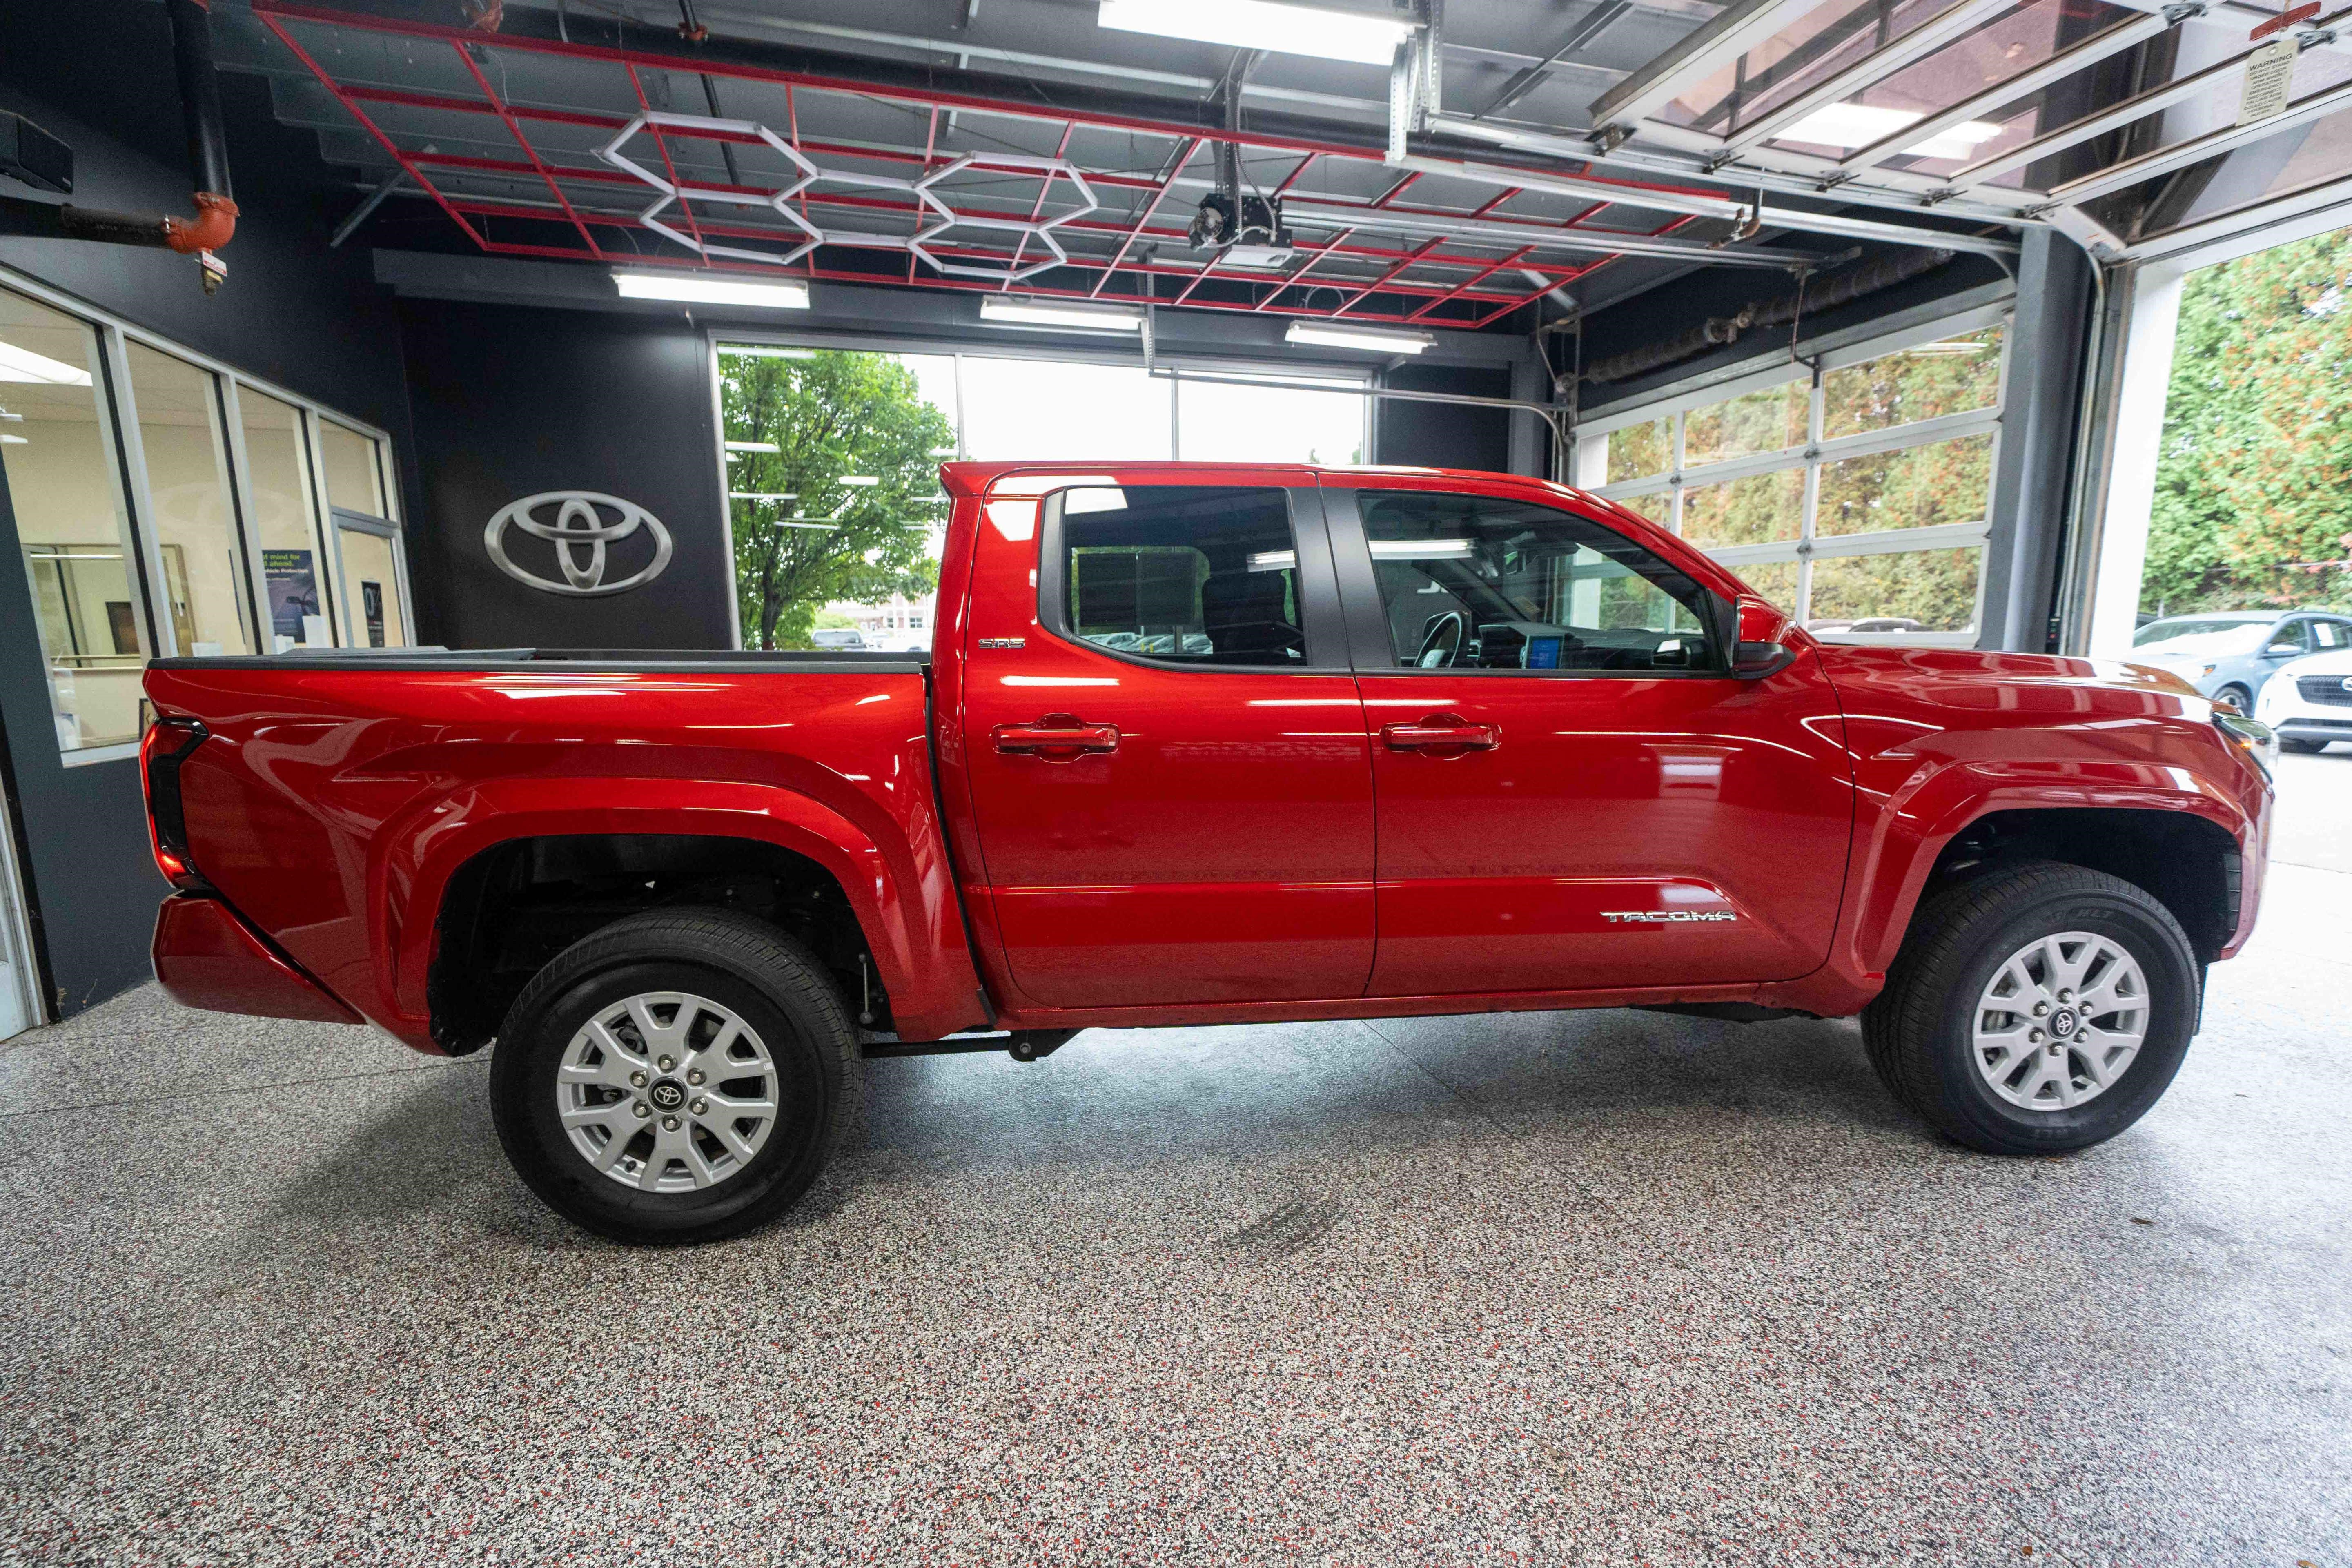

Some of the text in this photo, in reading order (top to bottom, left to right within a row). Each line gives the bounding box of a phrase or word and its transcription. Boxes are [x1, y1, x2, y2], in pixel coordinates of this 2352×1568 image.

[2249, 53, 2293, 71] WARNING
[2272, 60, 2290, 69] STAND
[2250, 72, 2269, 80] UNDER
[2249, 82, 2283, 96] EMERGENCY
[2250, 78, 2281, 89] OPERATING
[978, 638, 1025, 649] SR5
[1600, 911, 1737, 923] TACOMA
